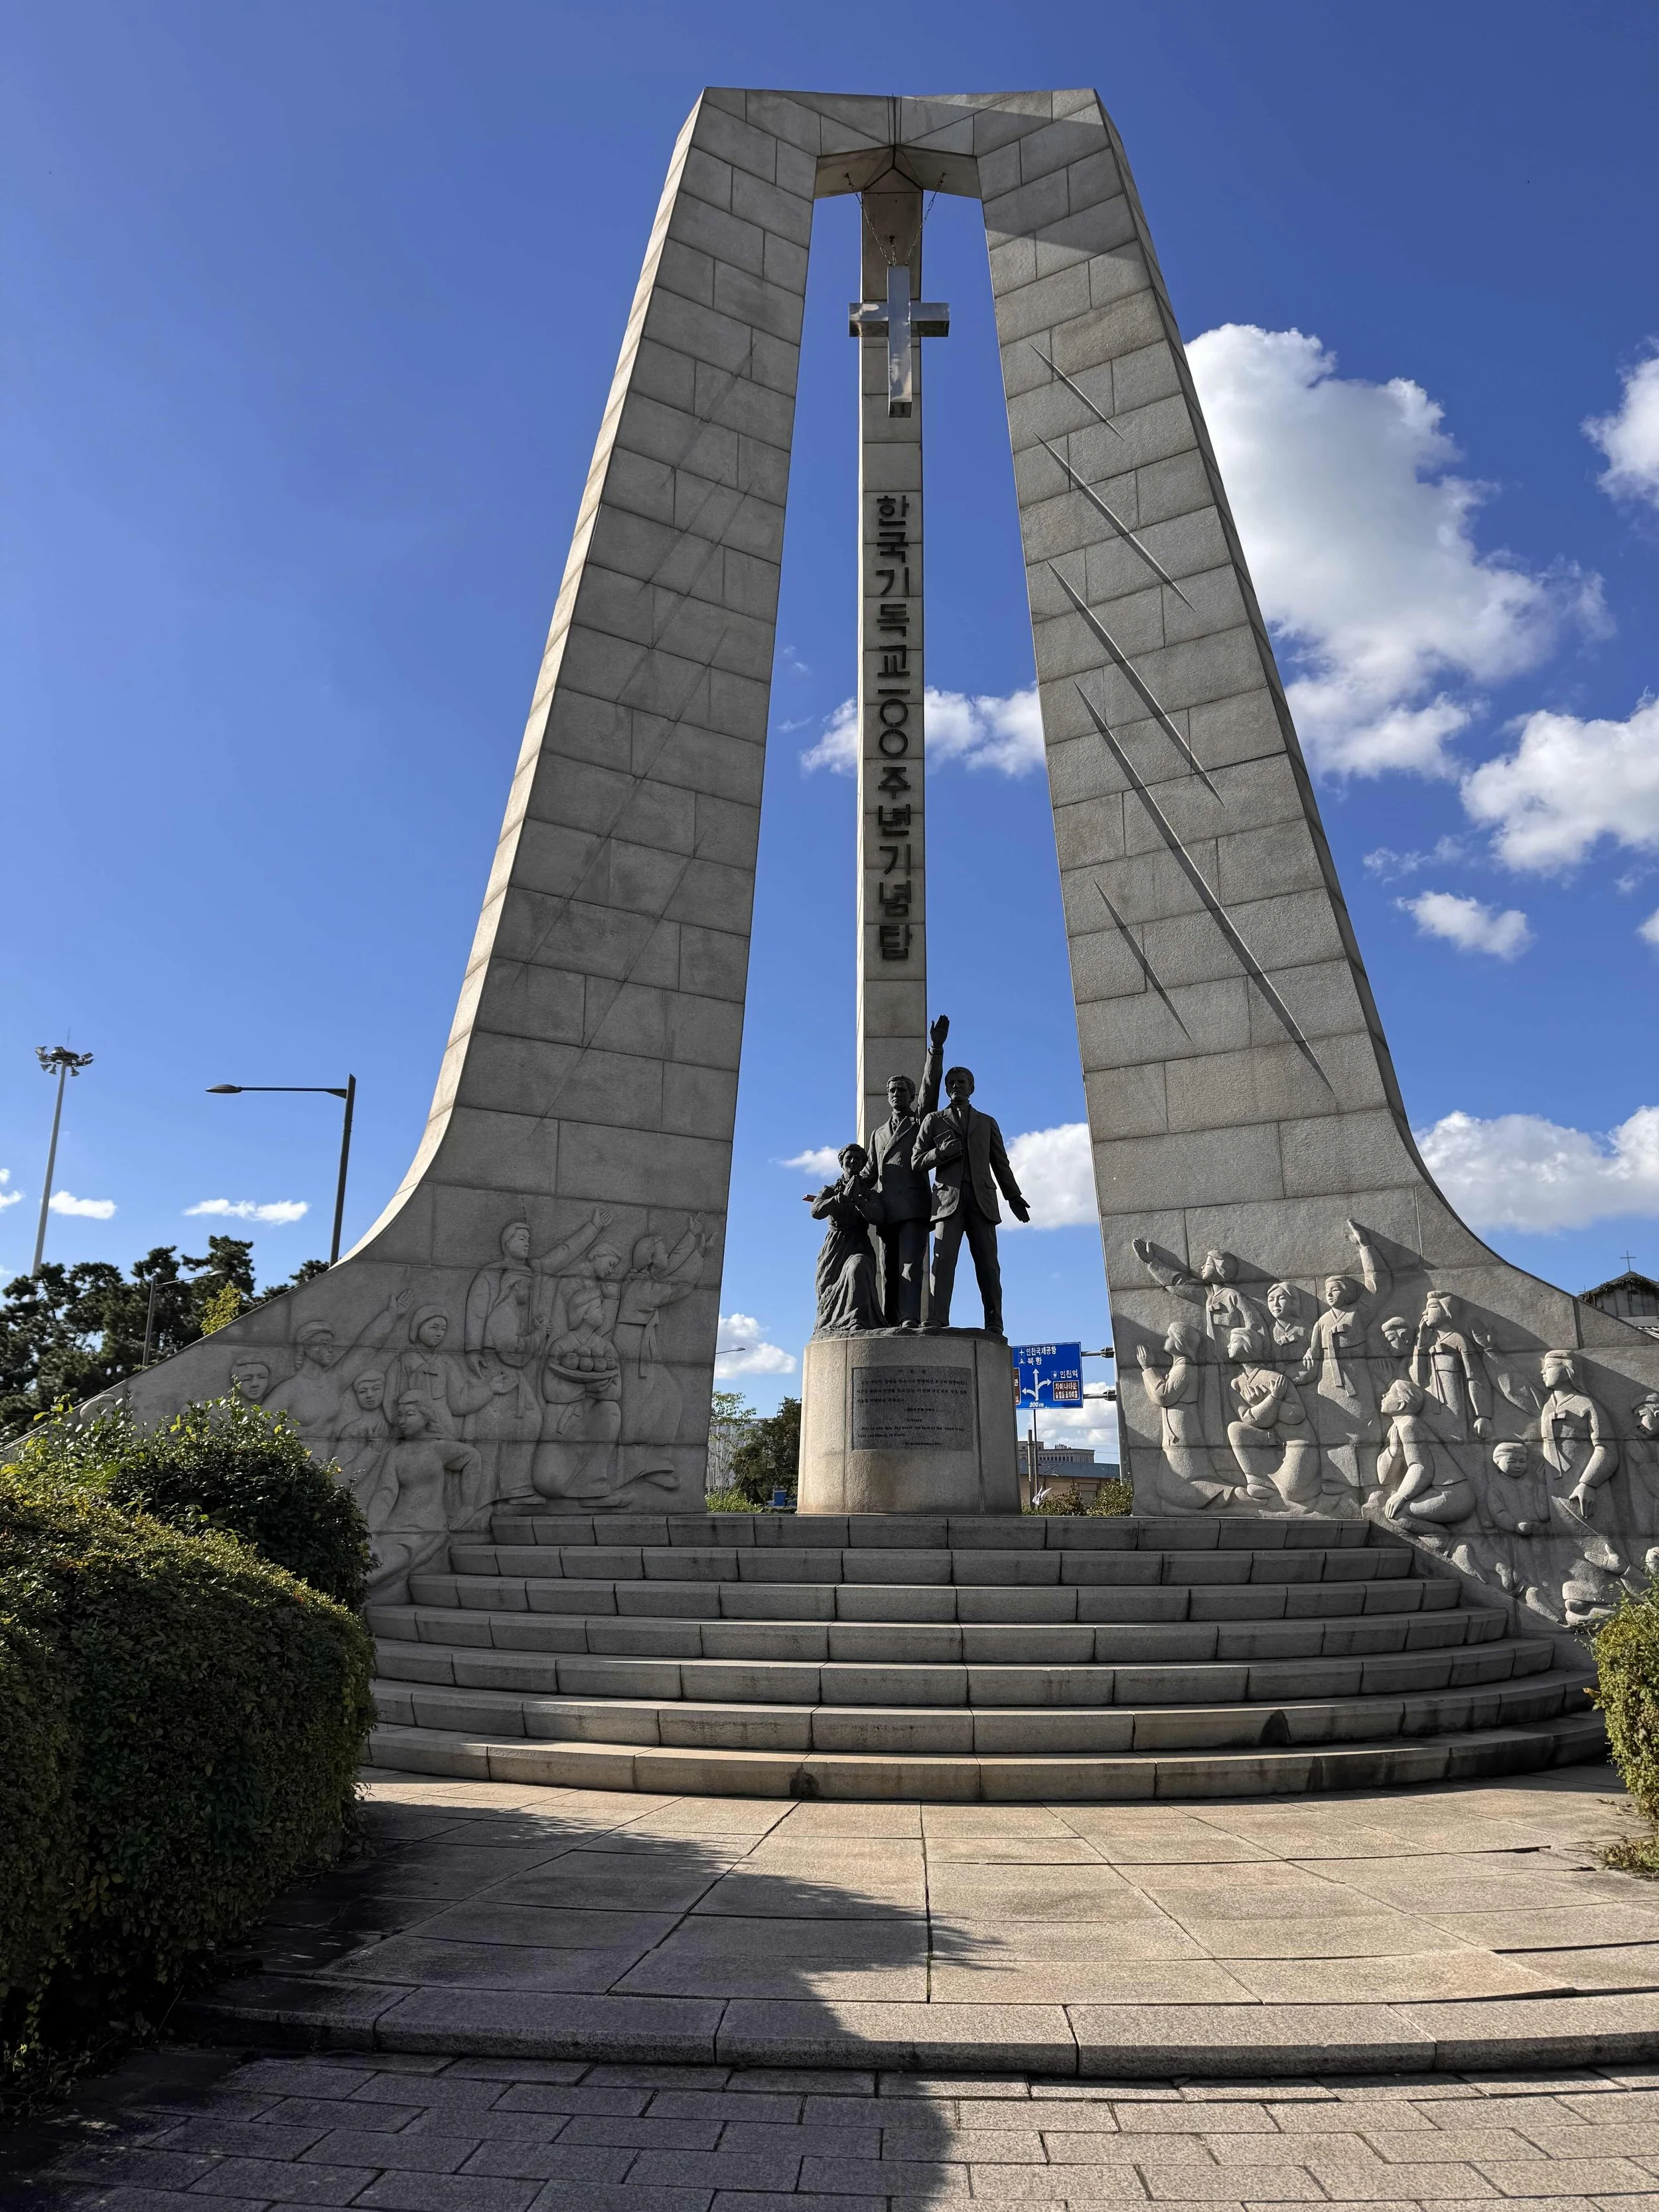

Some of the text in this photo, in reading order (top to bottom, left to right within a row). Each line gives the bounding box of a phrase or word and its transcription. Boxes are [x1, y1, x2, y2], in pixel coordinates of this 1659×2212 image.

[1026, 1346, 1056, 1356] 인천국제공항
[1060, 1369, 1078, 1378] 인천역
[1054, 1382, 1077, 1390] 차이나타운
